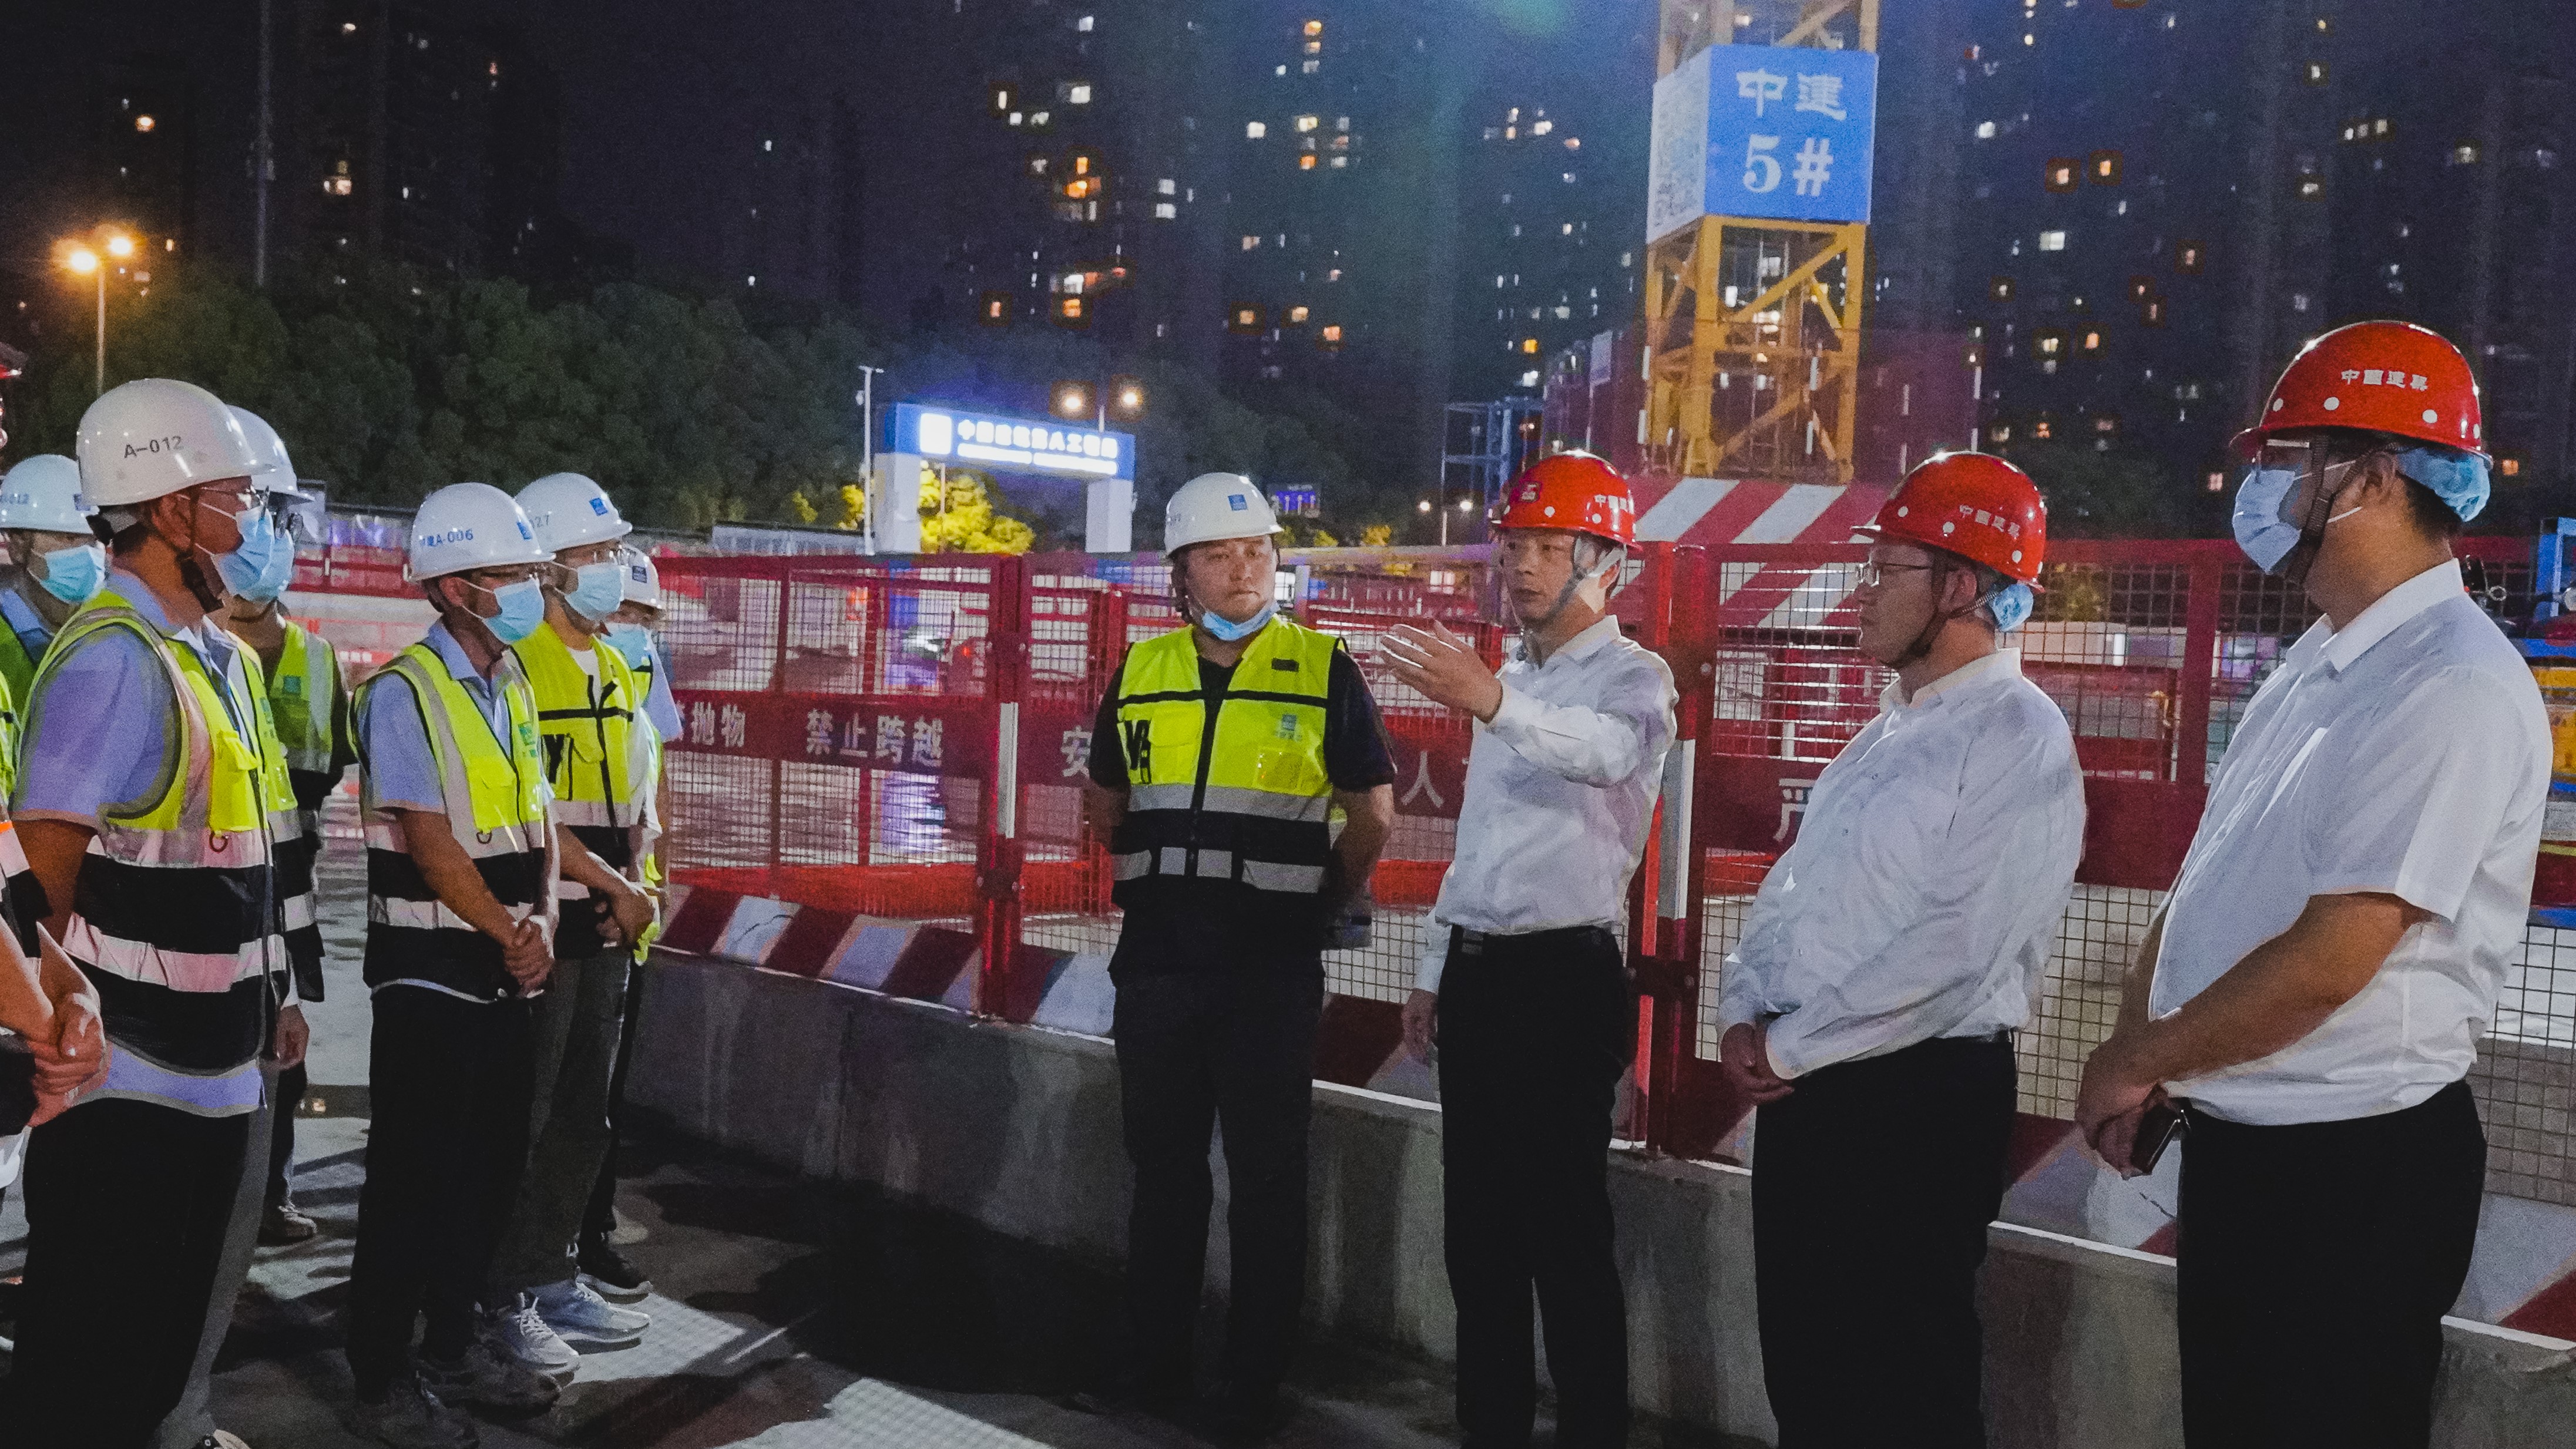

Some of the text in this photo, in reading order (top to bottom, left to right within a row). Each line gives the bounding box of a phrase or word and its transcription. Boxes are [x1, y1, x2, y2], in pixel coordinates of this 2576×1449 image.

[1736, 68, 1847, 121] 中建
[1742, 133, 1834, 197] 5#
[124, 435, 183, 459] A-012
[676, 700, 943, 768] 抛物 禁止跨越
